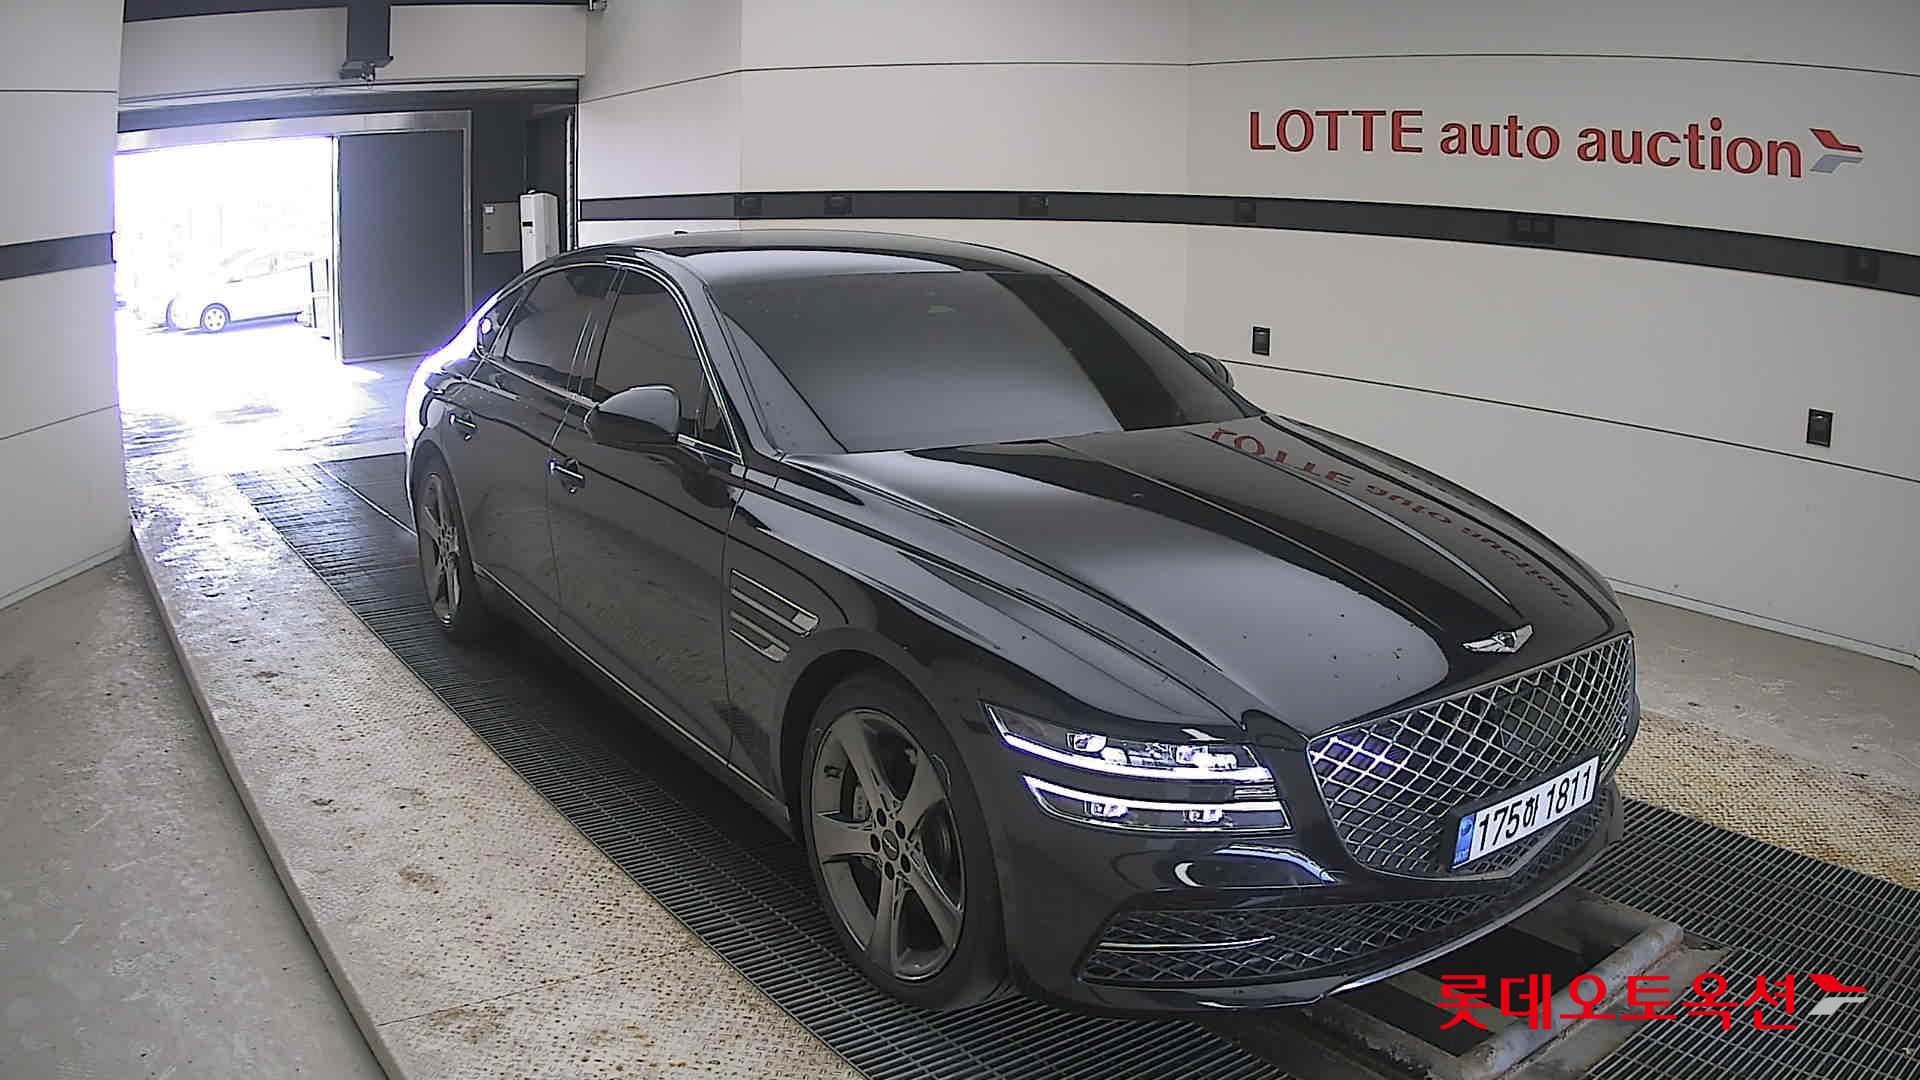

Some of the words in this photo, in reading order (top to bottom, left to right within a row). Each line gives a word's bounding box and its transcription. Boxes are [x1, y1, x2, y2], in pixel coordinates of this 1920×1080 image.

[1248, 109, 1424, 154] LOTTE
[1438, 114, 1562, 160] auto
[1576, 116, 1805, 178] auction
[1479, 794, 1541, 852] 175하
[1546, 765, 1592, 820] 1811
